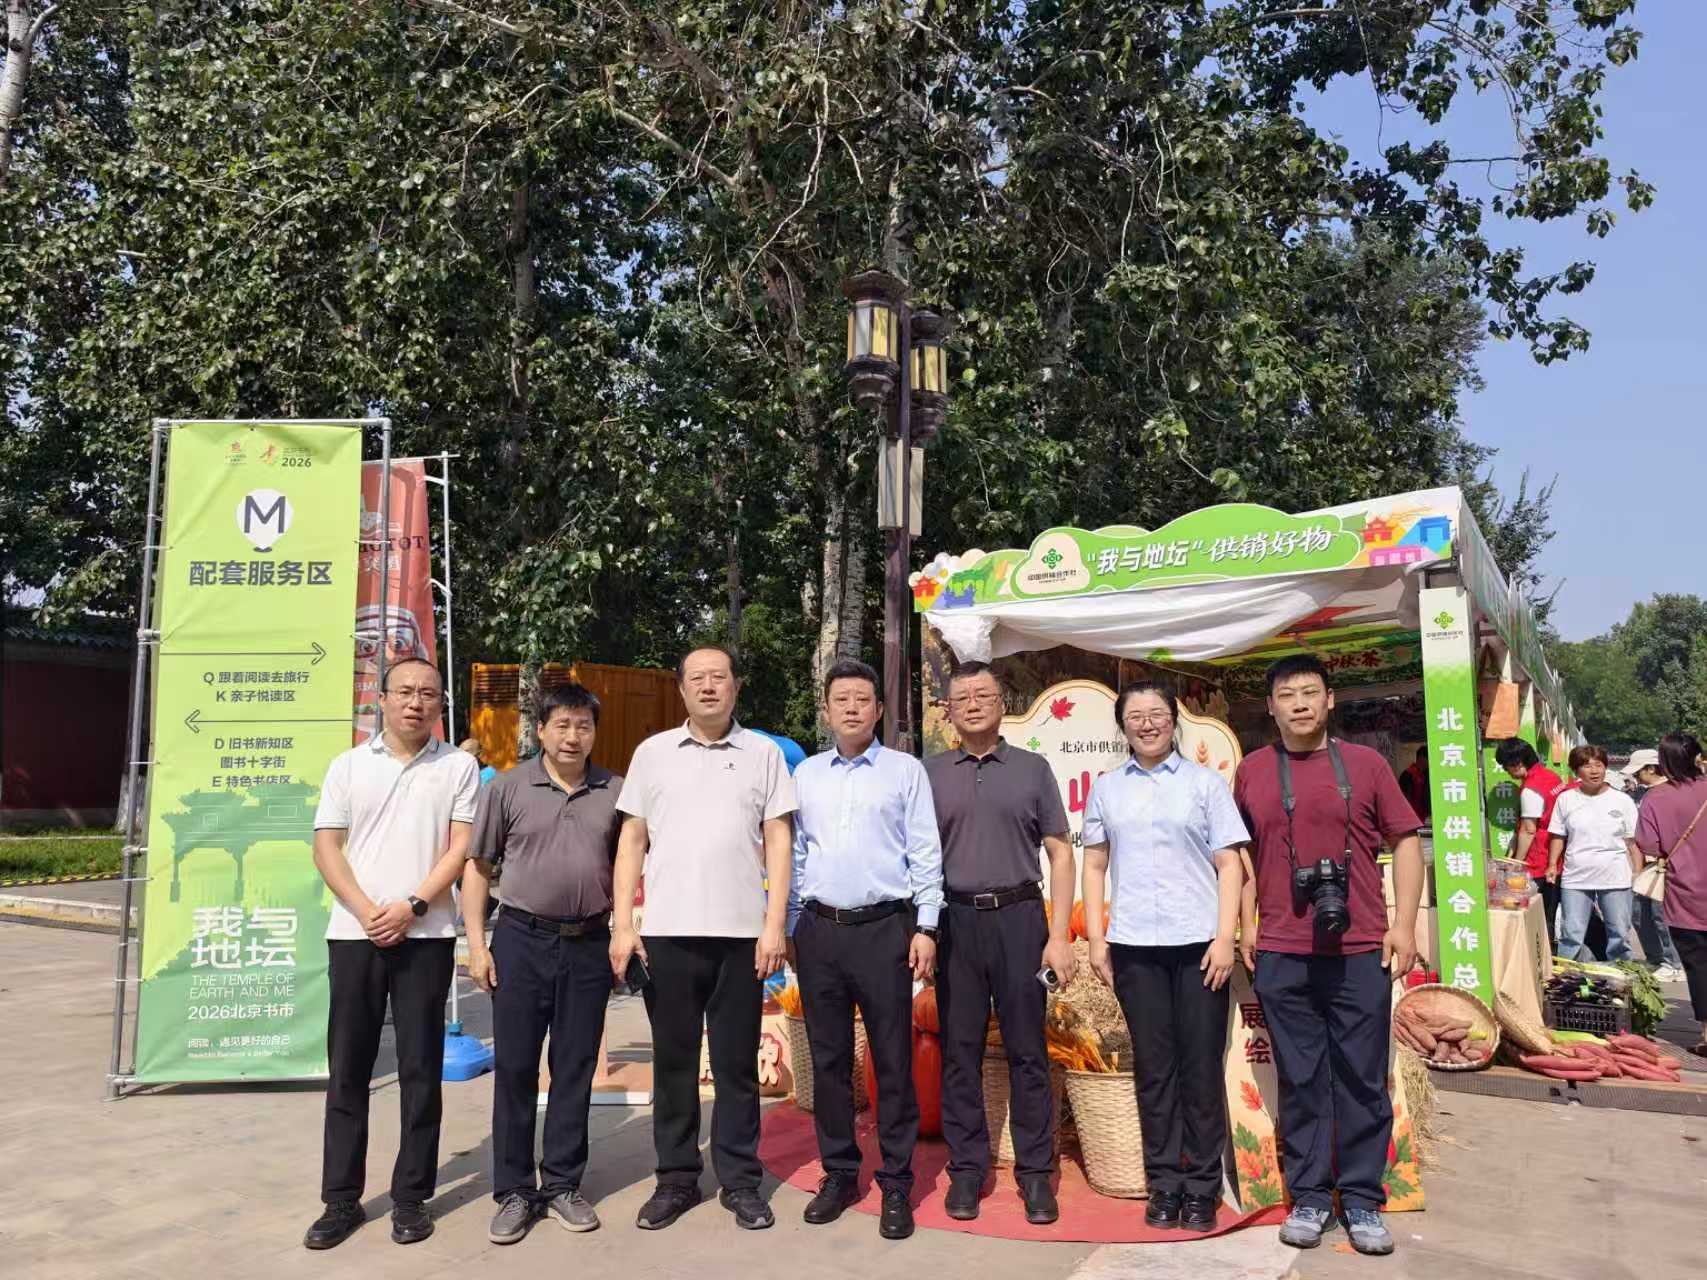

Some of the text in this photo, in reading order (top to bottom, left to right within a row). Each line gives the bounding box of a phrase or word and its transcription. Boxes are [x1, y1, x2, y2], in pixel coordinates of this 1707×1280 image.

[281, 457, 312, 468] 2026
[243, 495, 287, 534] M
[189, 560, 333, 586] 配套服务区
[203, 671, 310, 686] Q 跟着阅读去旅行
[216, 690, 296, 703] K 亲子悦读区
[214, 736, 294, 749] D 旧书新知区
[220, 755, 286, 768] 图书十字街
[212, 775, 291, 788] E 特色书店区
[193, 907, 297, 943] 我与
[191, 938, 296, 968] 地坛
[191, 972, 295, 986] THE TEMPLE OF
[189, 985, 295, 1000] EARTH AND ME
[187, 1002, 295, 1020] 2026北京书市
